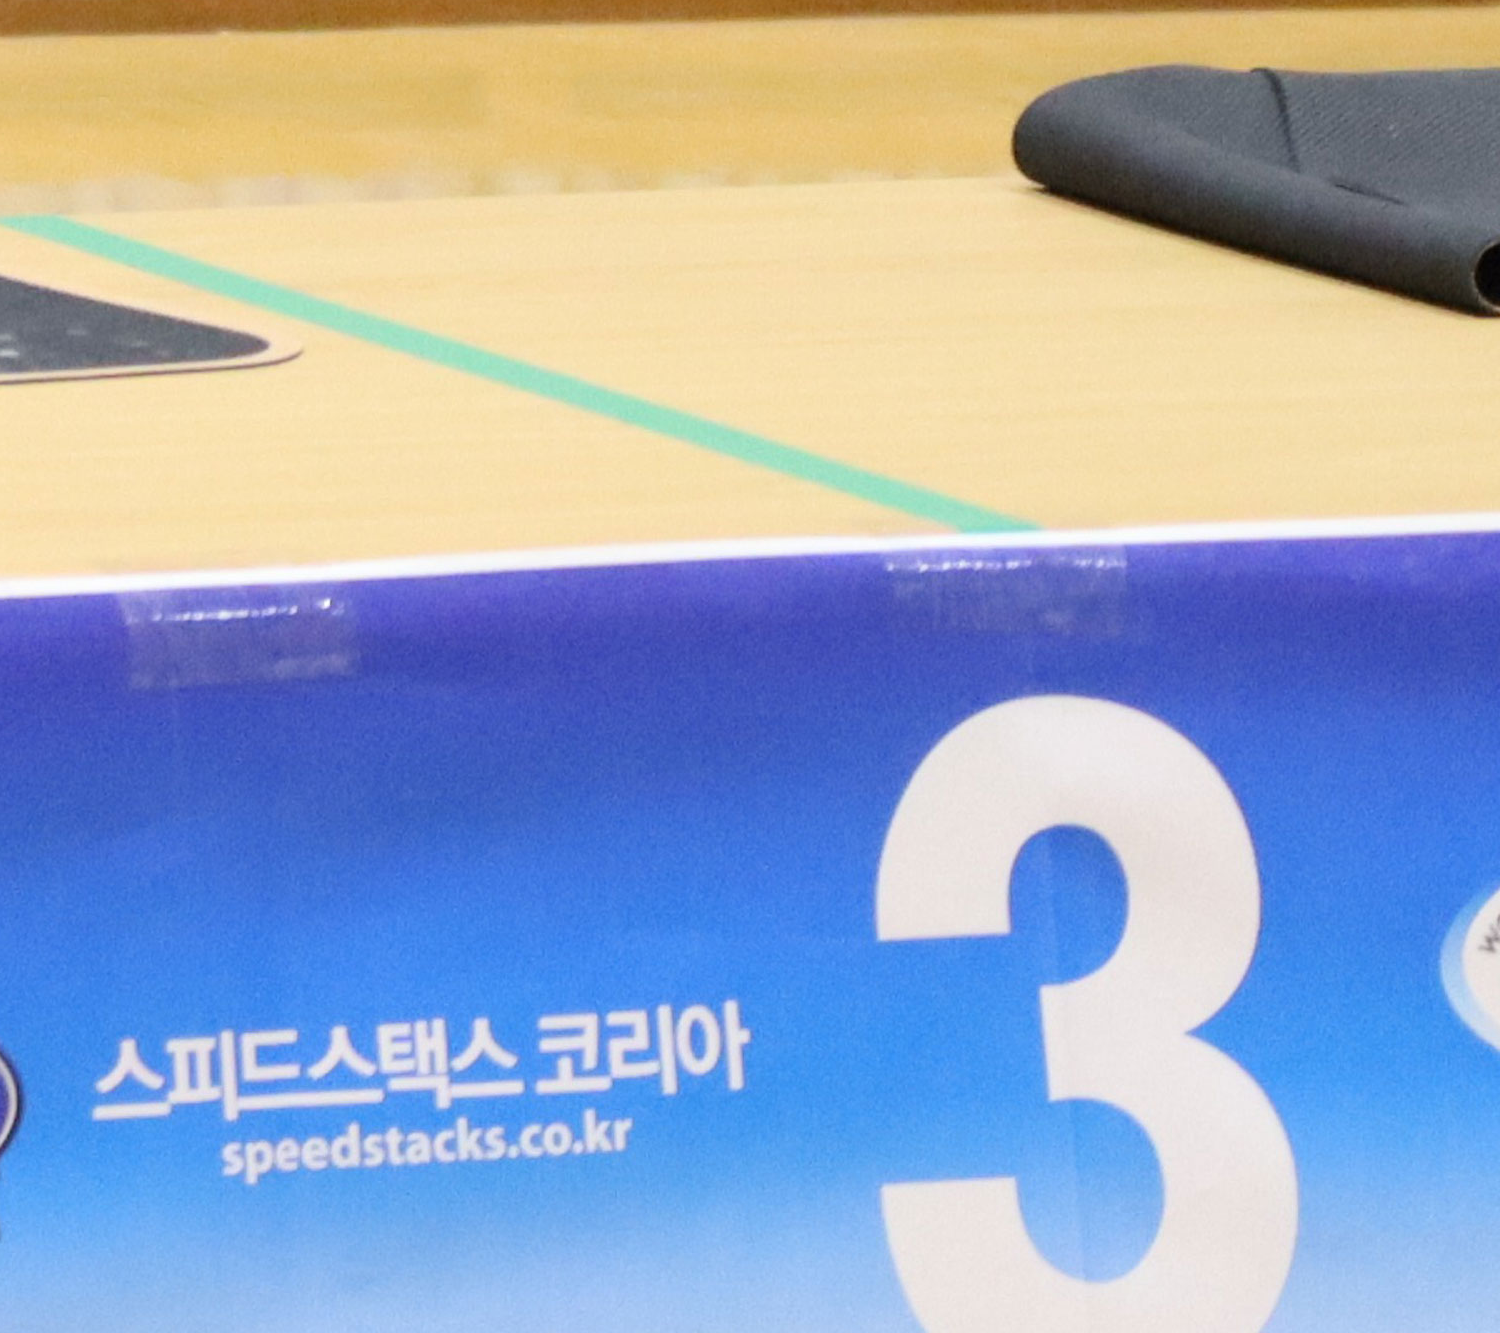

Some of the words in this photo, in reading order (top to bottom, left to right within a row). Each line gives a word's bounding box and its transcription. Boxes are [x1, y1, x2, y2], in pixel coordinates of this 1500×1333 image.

[92, 1017, 526, 1121] 스피드스택스
[534, 999, 751, 1095] 코리아
[874, 693, 1300, 1333] 3
[221, 1108, 634, 1185] speedstacks.co.kr
